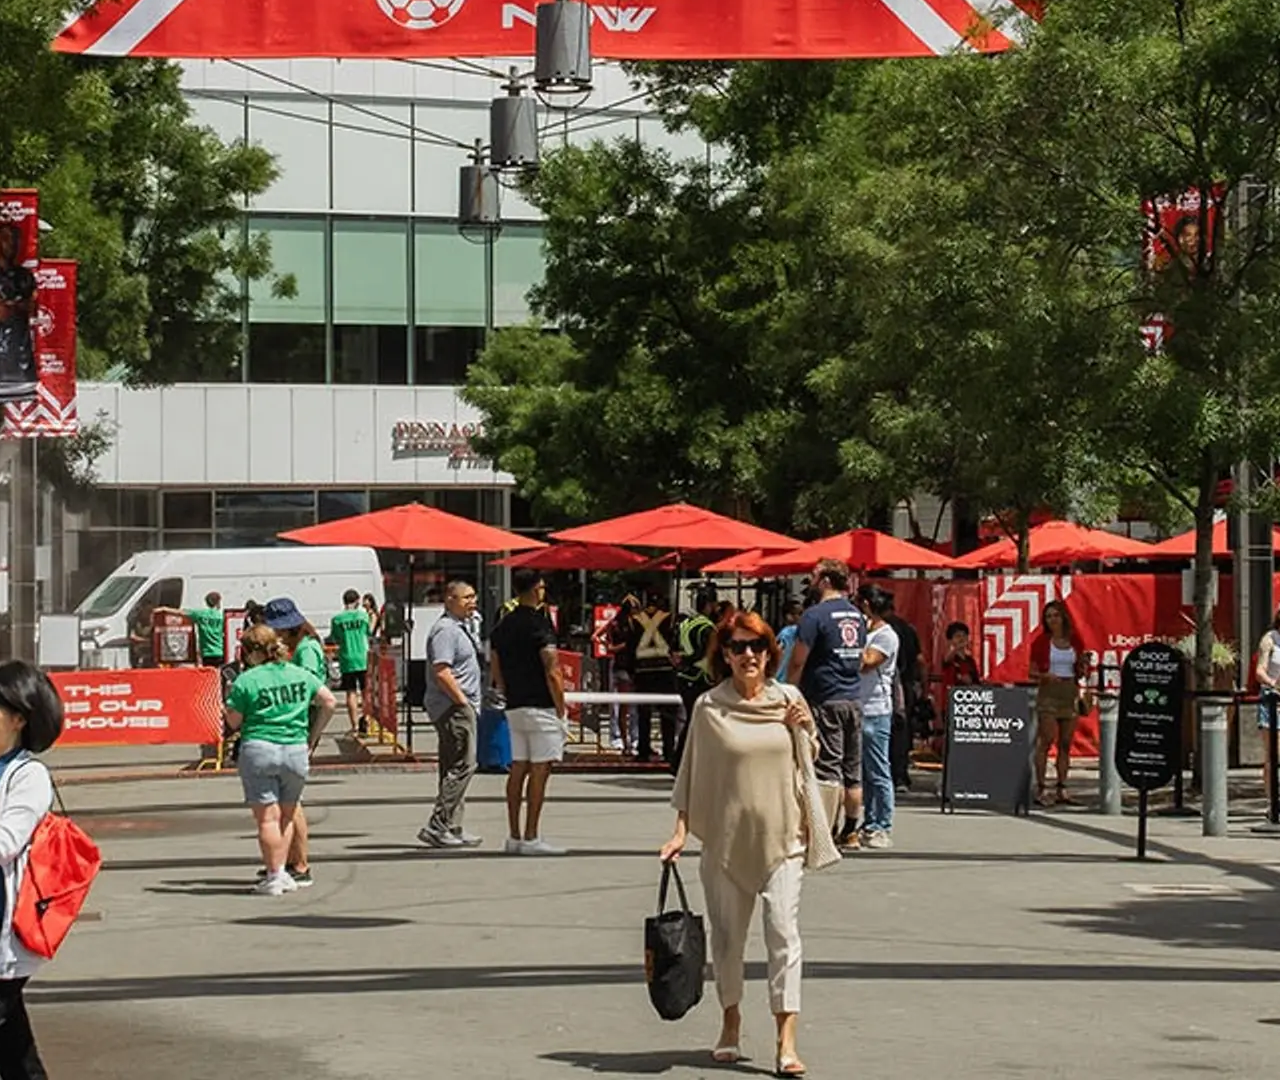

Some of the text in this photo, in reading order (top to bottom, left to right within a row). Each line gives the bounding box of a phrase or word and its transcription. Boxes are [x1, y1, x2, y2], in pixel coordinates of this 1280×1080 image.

[502, 3, 657, 33] NW
[1108, 634, 1141, 647] Uber
[1138, 651, 1171, 661] SHOOT
[1130, 660, 1153, 669] YOUR
[64, 684, 132, 697] THIS
[258, 681, 308, 710] STAFF
[954, 689, 994, 703] COME
[64, 699, 163, 713] IS OUR
[954, 704, 996, 716] KICK IT
[64, 716, 169, 729] HOUSE
[954, 716, 1013, 730] THIS WAY
